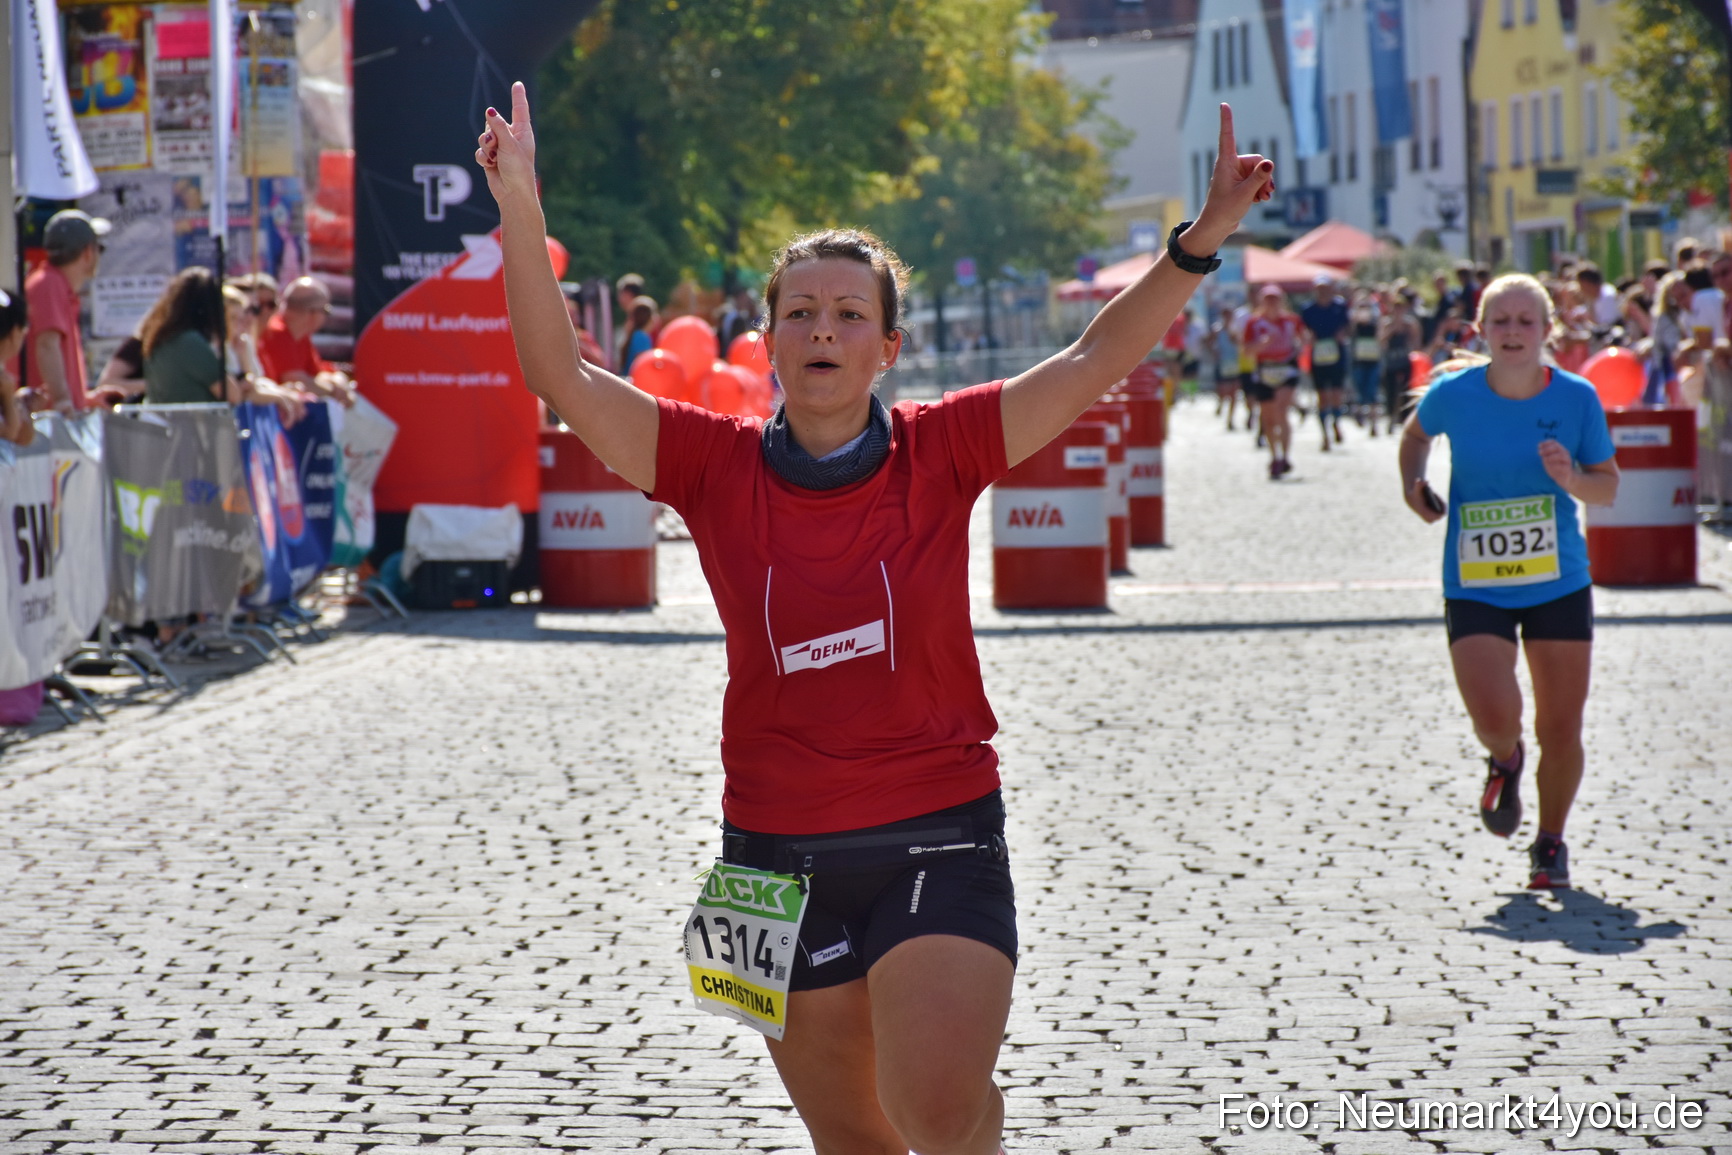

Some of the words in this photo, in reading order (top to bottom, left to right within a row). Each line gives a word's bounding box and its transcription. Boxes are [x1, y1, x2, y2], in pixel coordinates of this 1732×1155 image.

[43, 88, 72, 178] PARTL
[383, 313, 425, 330] BMW
[1468, 502, 1541, 524] BOCK
[1471, 526, 1546, 558] 1032
[1495, 564, 1526, 577] EVA
[811, 638, 856, 662] DEHN
[699, 871, 783, 910] OCK
[692, 914, 774, 979] 1314
[700, 974, 776, 1018] CHRISTINA
